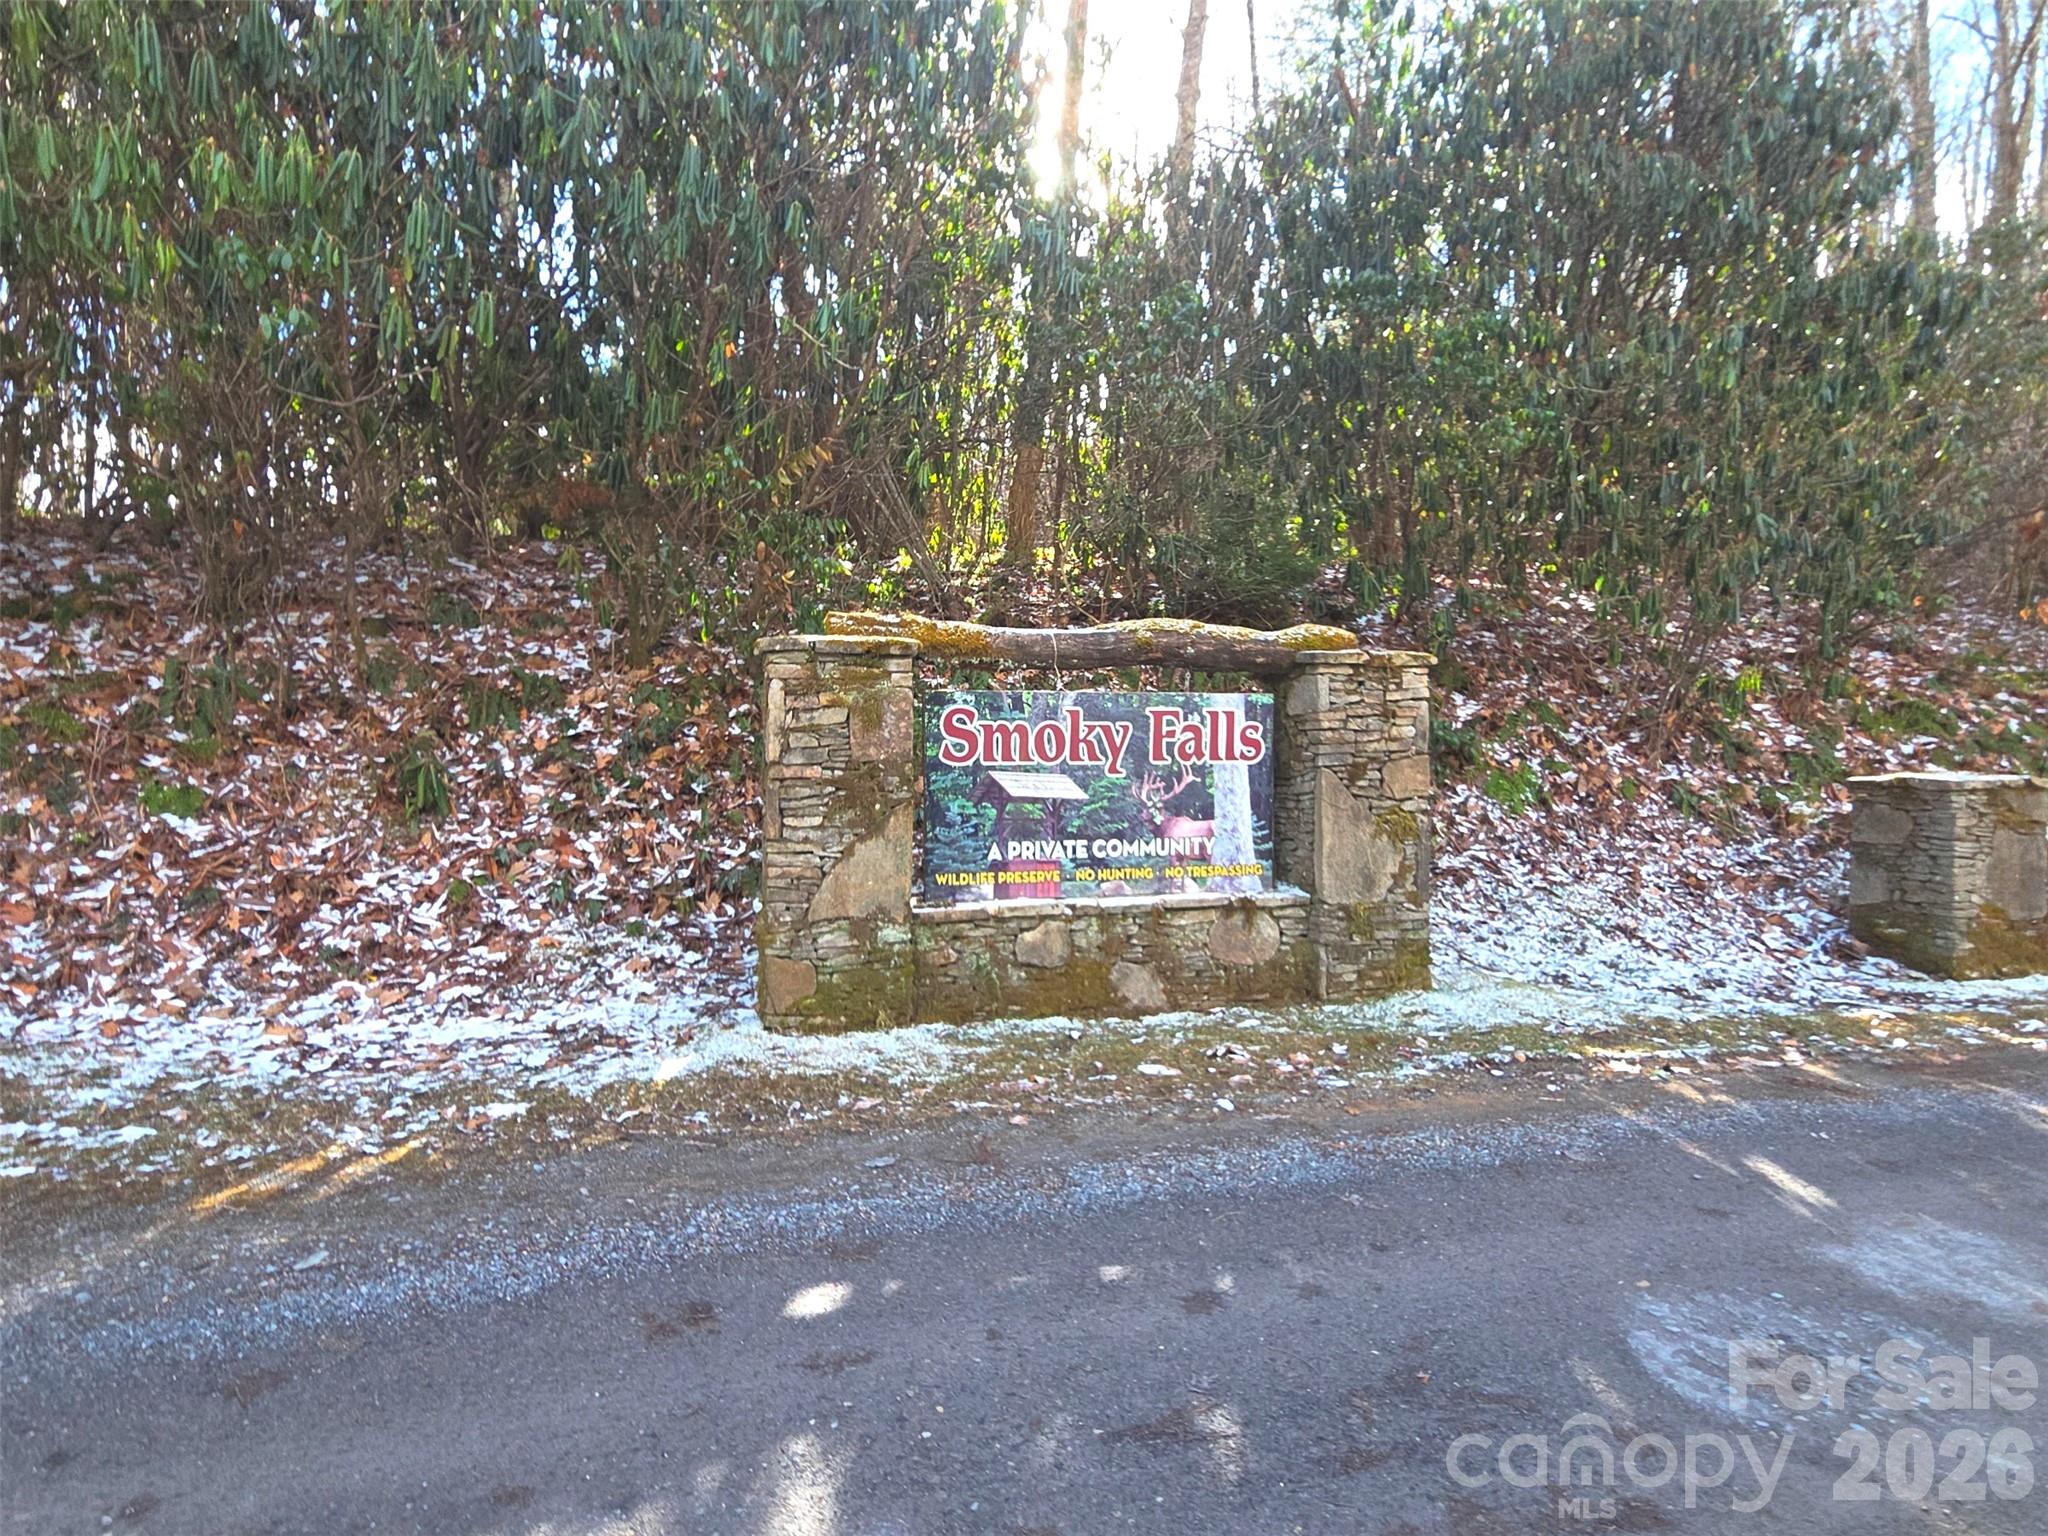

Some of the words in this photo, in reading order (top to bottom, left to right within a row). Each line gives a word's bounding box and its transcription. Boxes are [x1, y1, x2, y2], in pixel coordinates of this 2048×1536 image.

[940, 706, 1132, 776] Smoky
[1147, 707, 1264, 764] Falls
[988, 840, 1003, 861] A
[1008, 839, 1088, 861] PRIVATE
[1092, 837, 1215, 858] COMMUNITY
[935, 872, 996, 886] WILDLIFE
[998, 870, 1060, 885] PRESERVE
[1075, 869, 1097, 881] NO
[1098, 867, 1153, 880] HUNTING
[1165, 866, 1185, 879] NO
[1186, 864, 1263, 878] TRESPASSING
